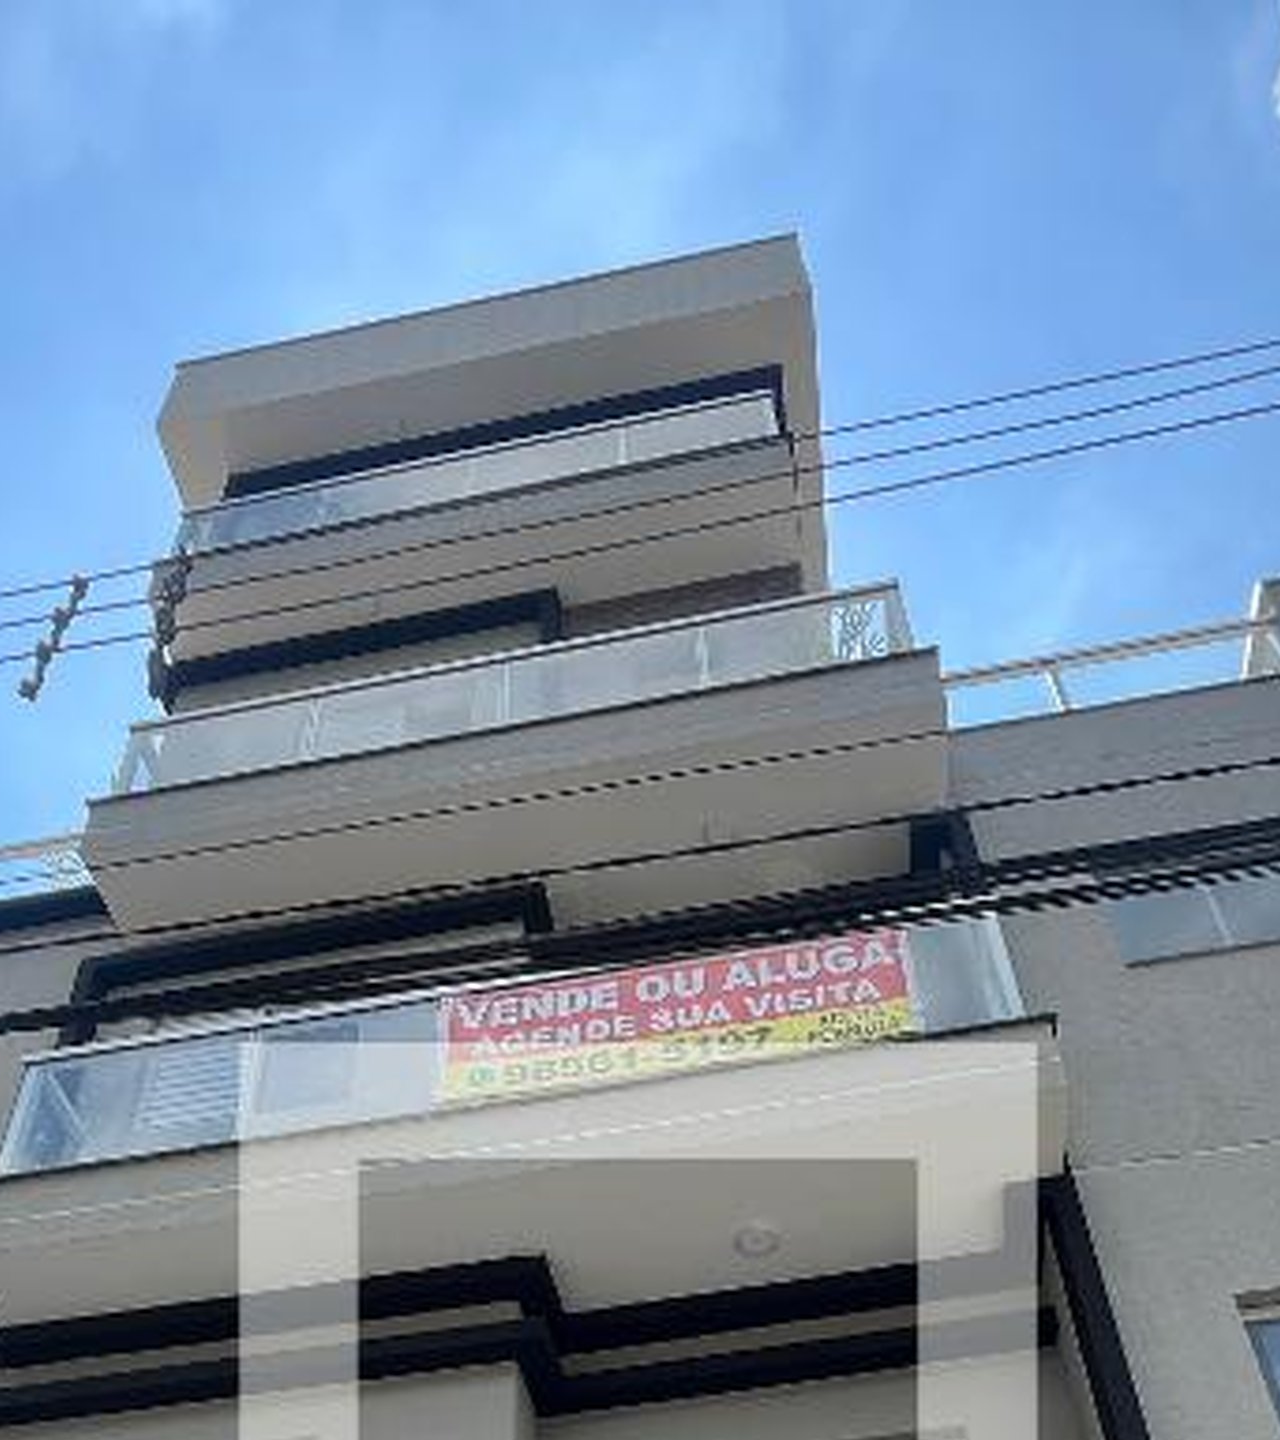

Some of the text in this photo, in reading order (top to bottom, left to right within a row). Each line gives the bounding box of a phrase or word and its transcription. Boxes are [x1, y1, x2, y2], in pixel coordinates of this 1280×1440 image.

[456, 935, 895, 1029] VENDE OU ALUGA
[468, 980, 882, 1060] AGENDE SUA VISITA
